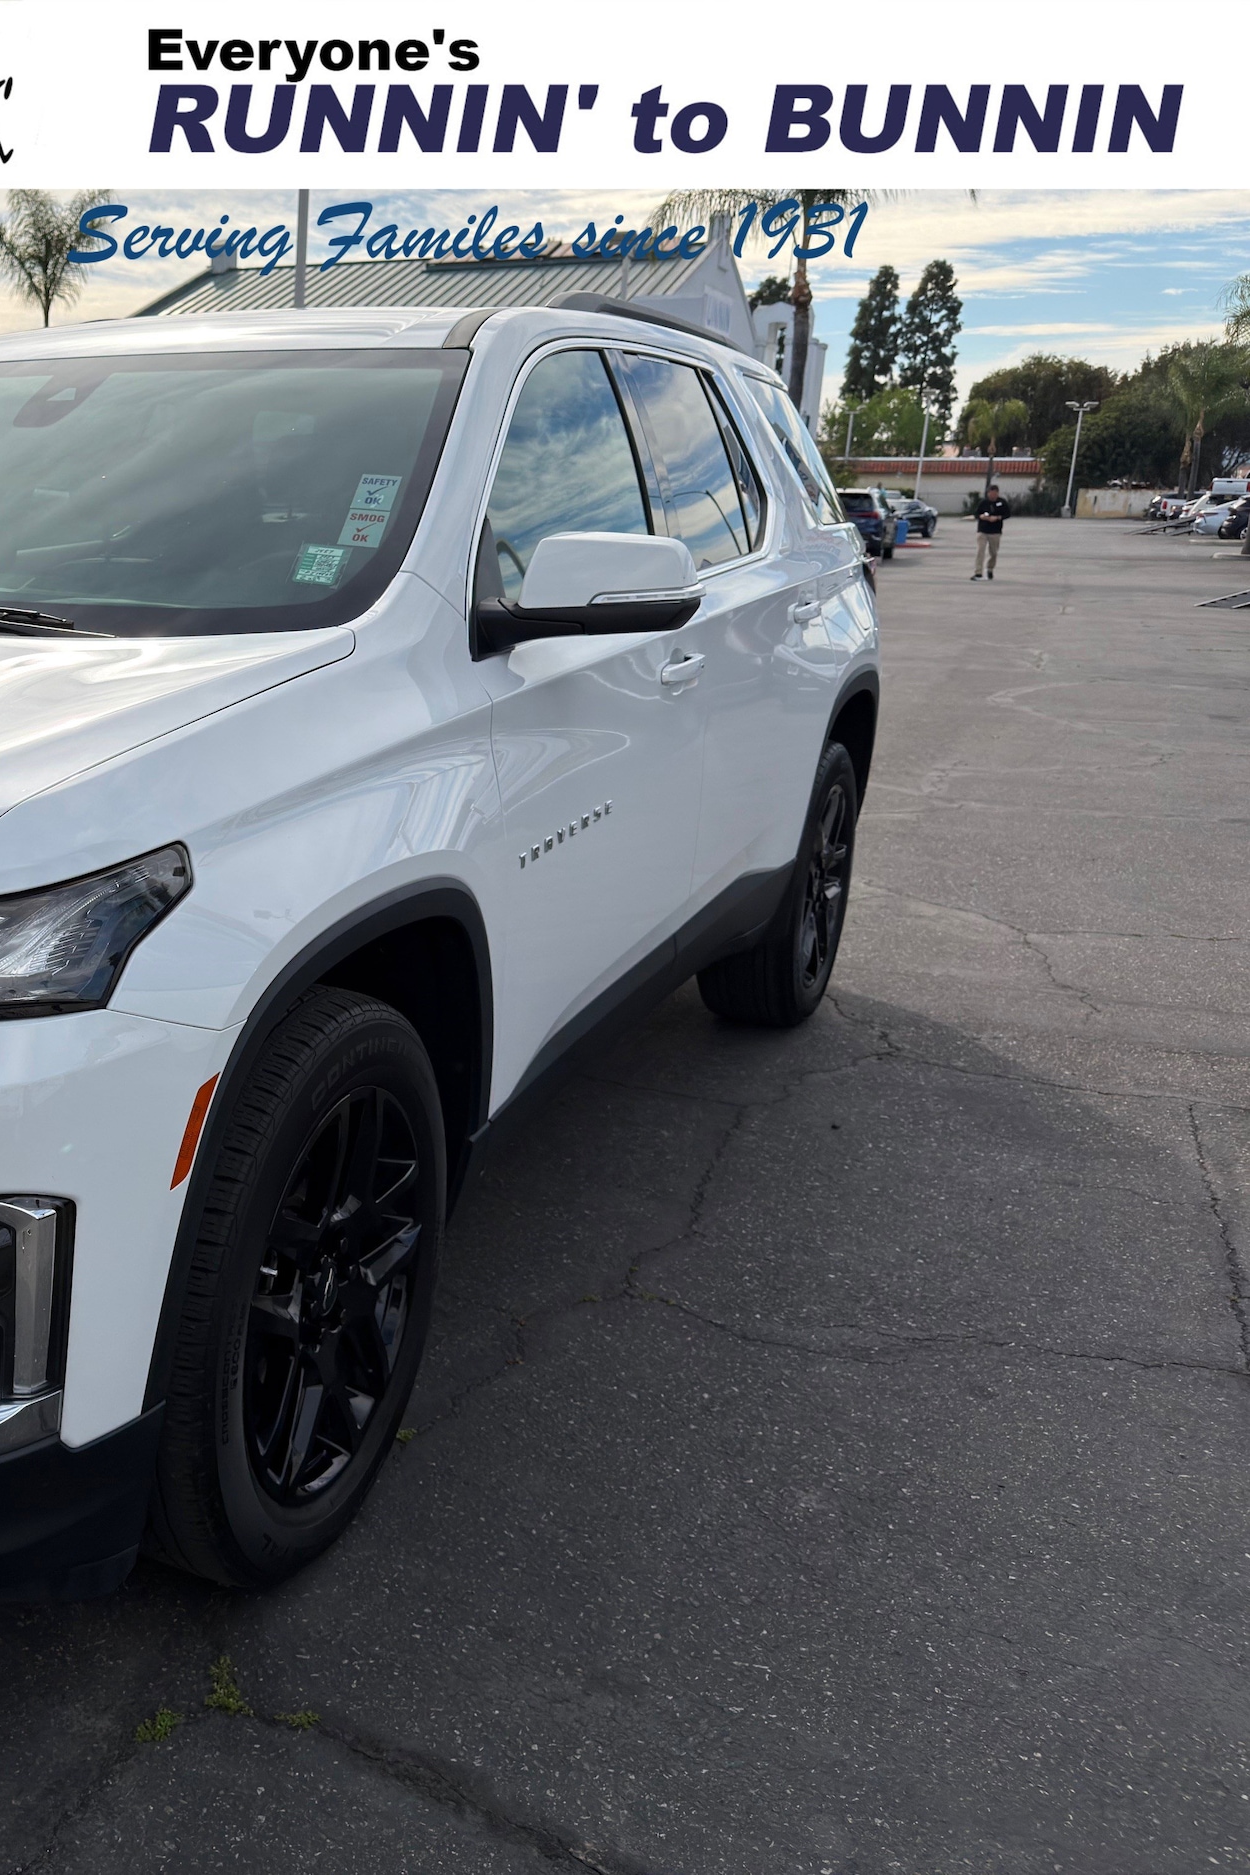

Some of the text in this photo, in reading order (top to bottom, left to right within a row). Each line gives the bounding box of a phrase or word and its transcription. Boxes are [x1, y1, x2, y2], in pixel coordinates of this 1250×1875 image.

[361, 477, 398, 487] SAFETY
[364, 496, 382, 506] OK
[350, 512, 385, 523] SMOG
[352, 533, 370, 543] OK
[518, 799, 614, 870] TRAVERSE
